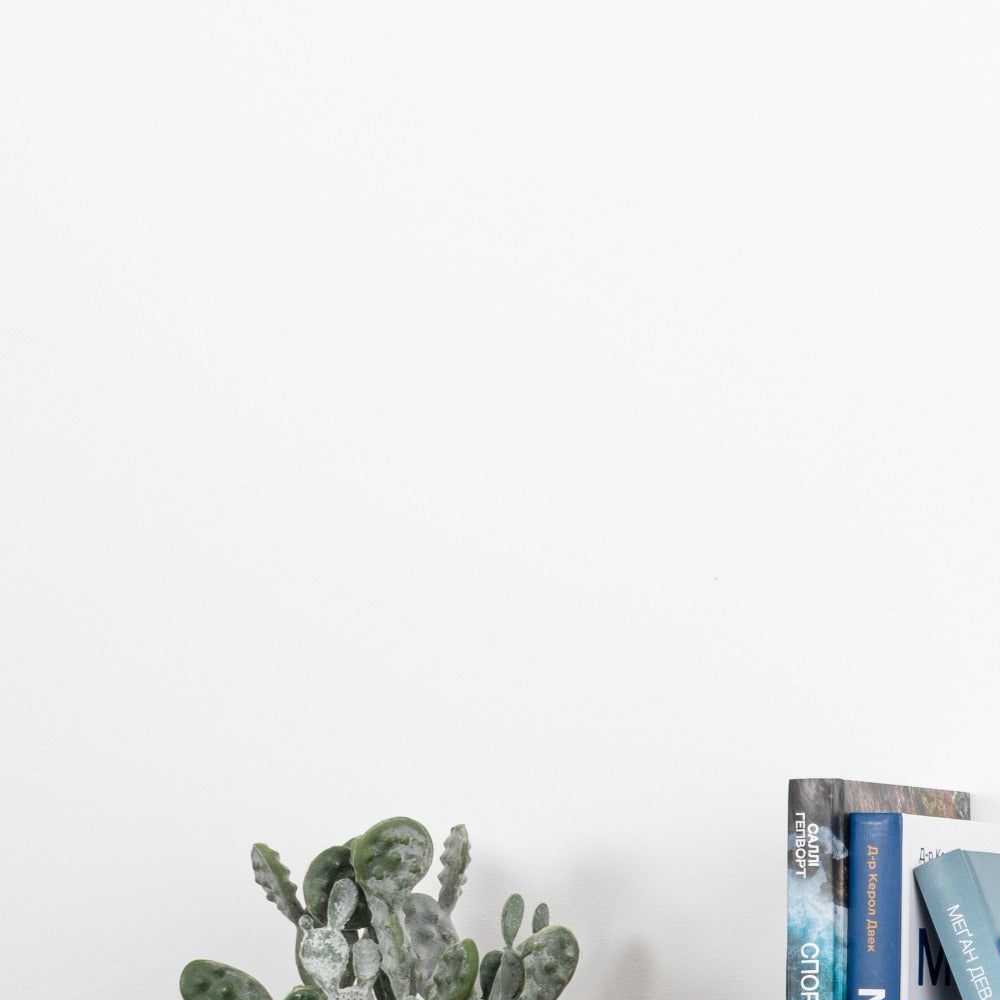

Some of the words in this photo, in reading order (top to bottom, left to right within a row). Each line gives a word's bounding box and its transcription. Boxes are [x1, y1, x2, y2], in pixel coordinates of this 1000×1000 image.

[795, 812, 807, 879] ГЕПВОРТ
[807, 822, 820, 867] САЛЛІ
[866, 845, 879, 870] Д-р
[866, 873, 879, 917] Керол
[866, 919, 879, 953] Двек
